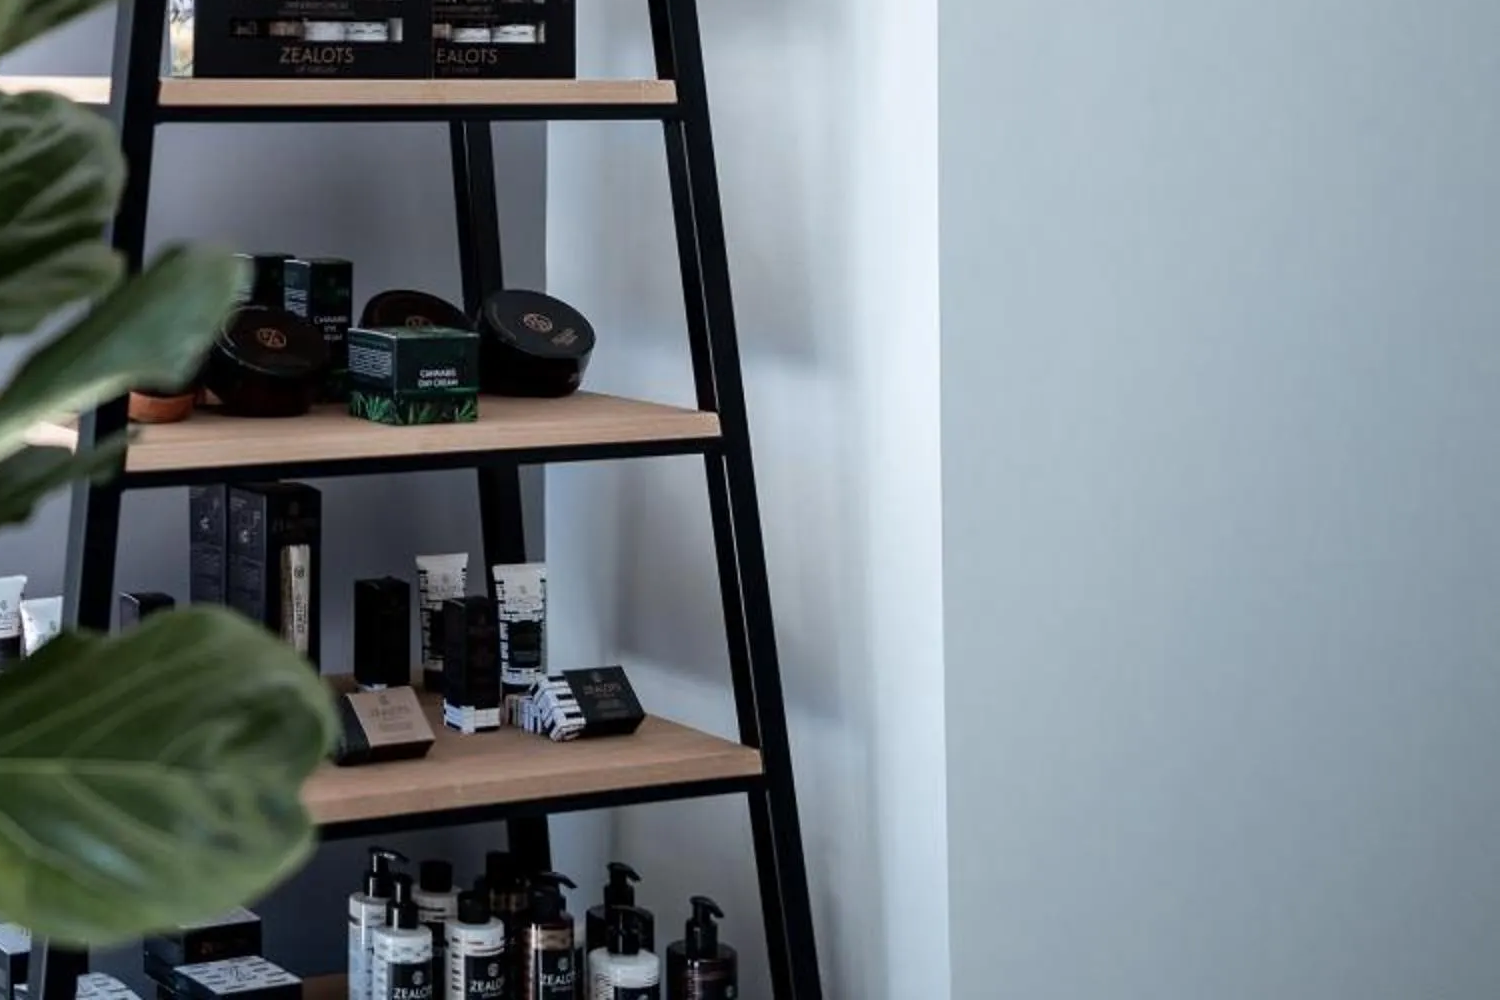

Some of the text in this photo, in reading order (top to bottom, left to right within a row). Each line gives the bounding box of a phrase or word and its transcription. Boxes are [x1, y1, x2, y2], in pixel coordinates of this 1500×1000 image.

[279, 46, 355, 65] ZEALOTS
[435, 48, 498, 66] EALOTS
[468, 976, 505, 994] ZEALO
